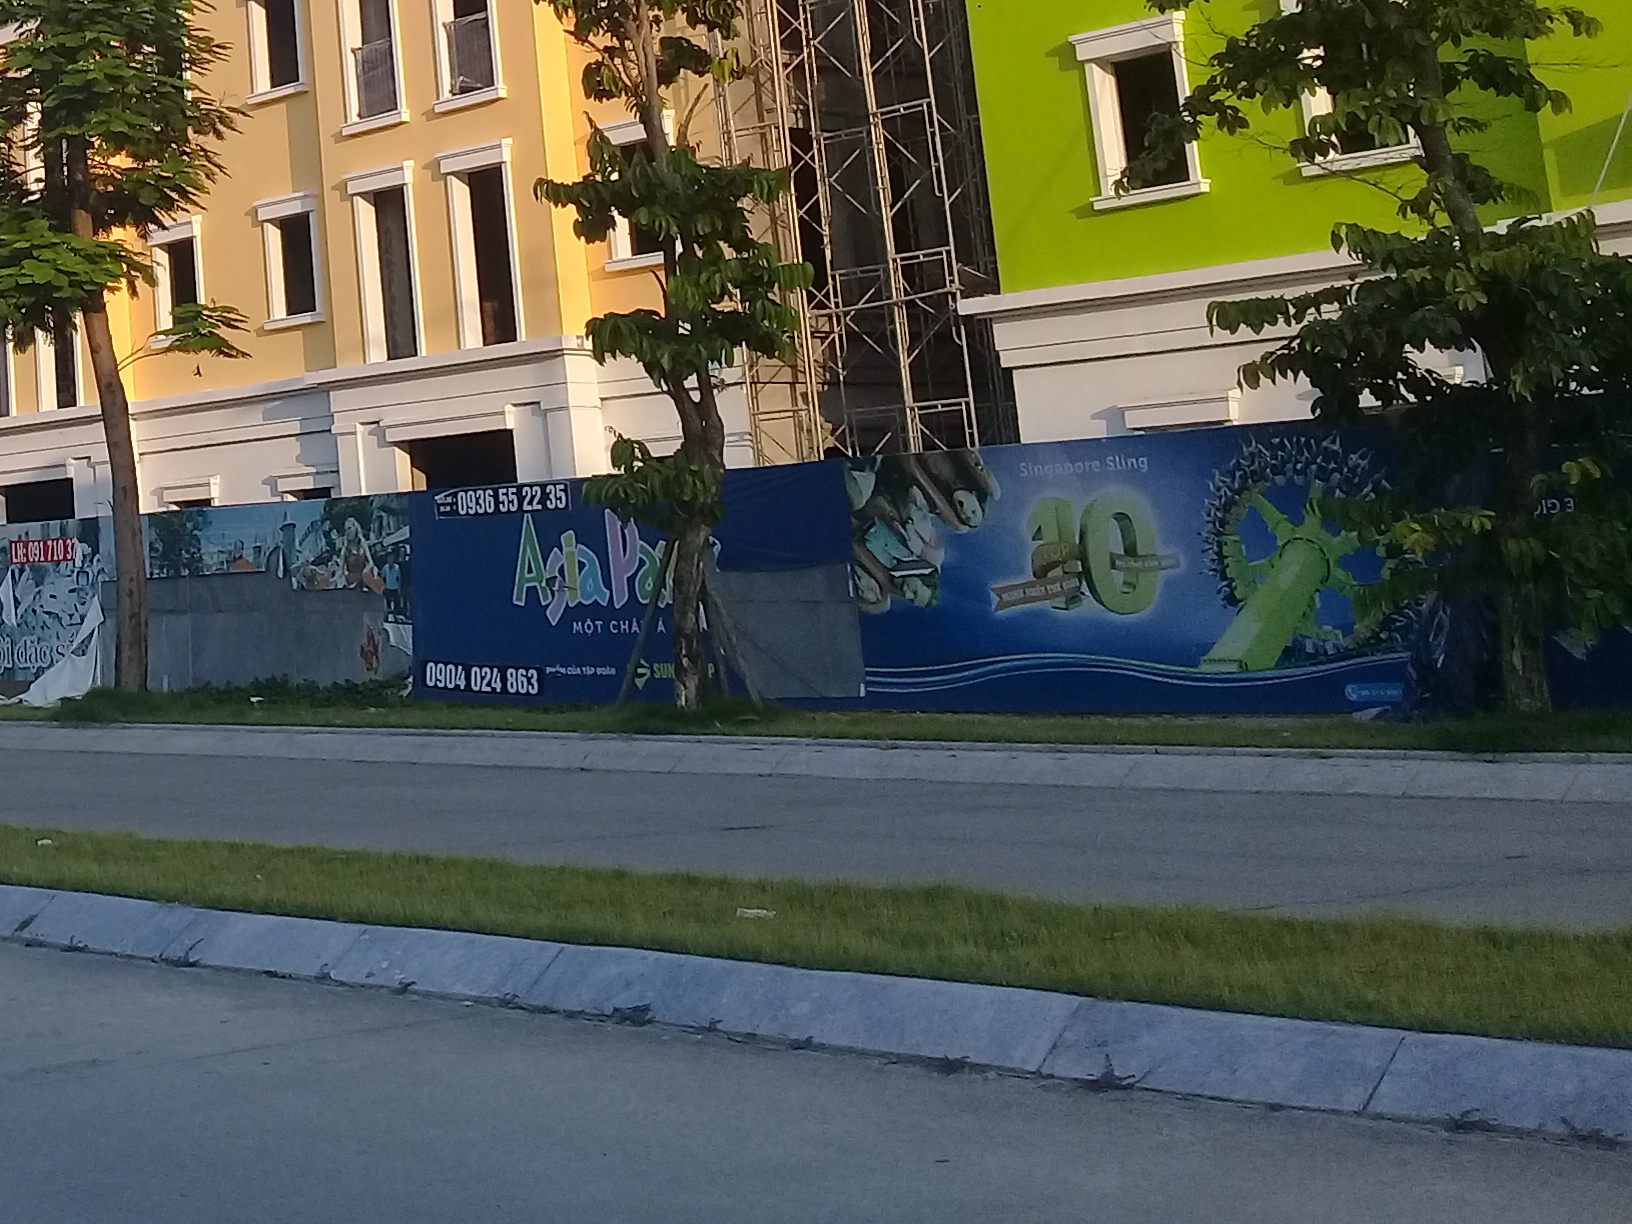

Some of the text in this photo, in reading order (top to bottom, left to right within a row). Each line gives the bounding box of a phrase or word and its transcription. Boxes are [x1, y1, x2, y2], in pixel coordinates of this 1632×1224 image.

[1106, 454, 1148, 473] Sling
[457, 489, 495, 515] 0936
[498, 486, 519, 513] 55
[522, 485, 543, 511] 22
[546, 483, 566, 509] 35
[28, 540, 45, 562] 091
[47, 538, 64, 561] 710
[512, 513, 610, 626] Asia
[572, 617, 604, 637] MỘT
[609, 616, 644, 635] CHÂ
[425, 661, 539, 695] 0904 024 863
